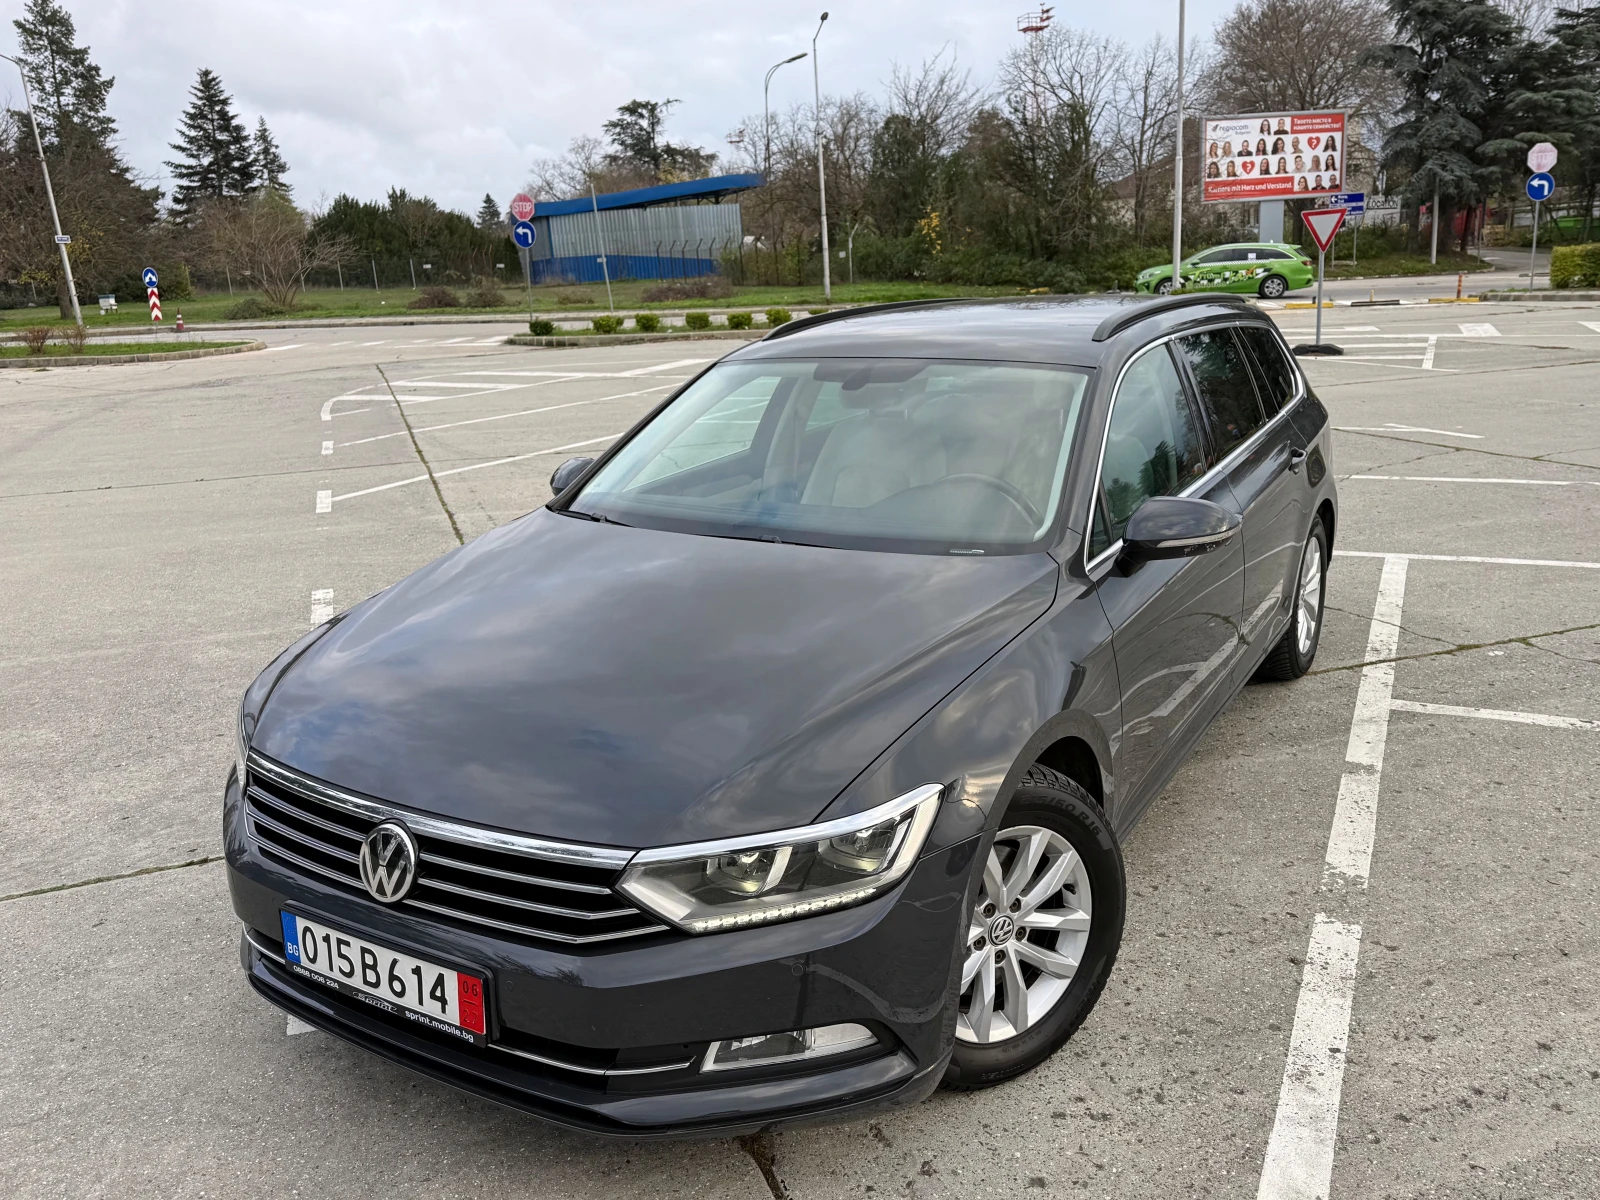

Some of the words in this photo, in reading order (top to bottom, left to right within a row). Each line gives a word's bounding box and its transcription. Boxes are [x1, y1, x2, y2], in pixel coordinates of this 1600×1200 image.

[1219, 124, 1249, 132] regiocom
[1531, 152, 1554, 163] STOP
[514, 202, 532, 212] STOP
[287, 942, 299, 957] BG
[463, 980, 478, 996] 06
[463, 1008, 478, 1024] 27
[404, 1010, 474, 1044] sprint.mobile.bg
